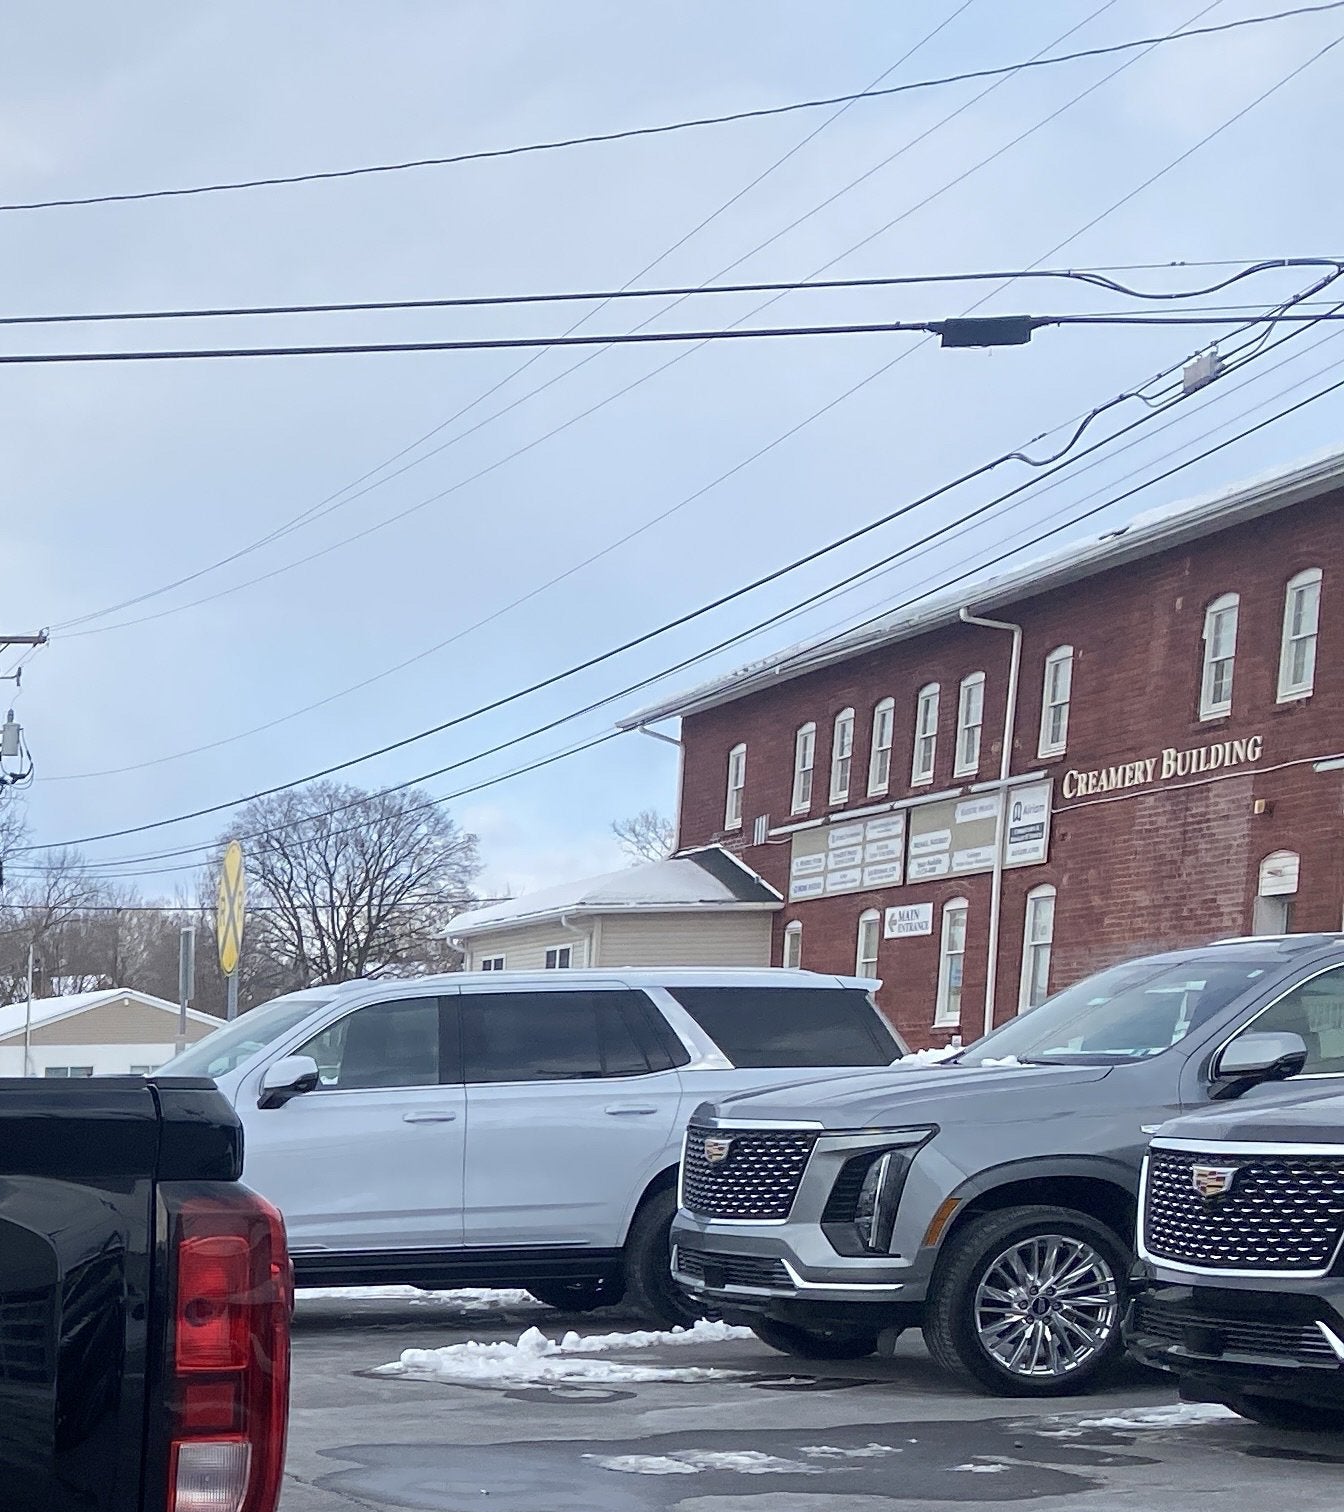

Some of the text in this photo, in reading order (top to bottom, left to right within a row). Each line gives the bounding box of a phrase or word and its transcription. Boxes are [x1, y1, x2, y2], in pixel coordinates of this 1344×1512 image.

[1063, 735, 1263, 799] CREAMERY BUILDING
[898, 909, 919, 922] MAIN
[898, 920, 929, 933] ENTRANCE
